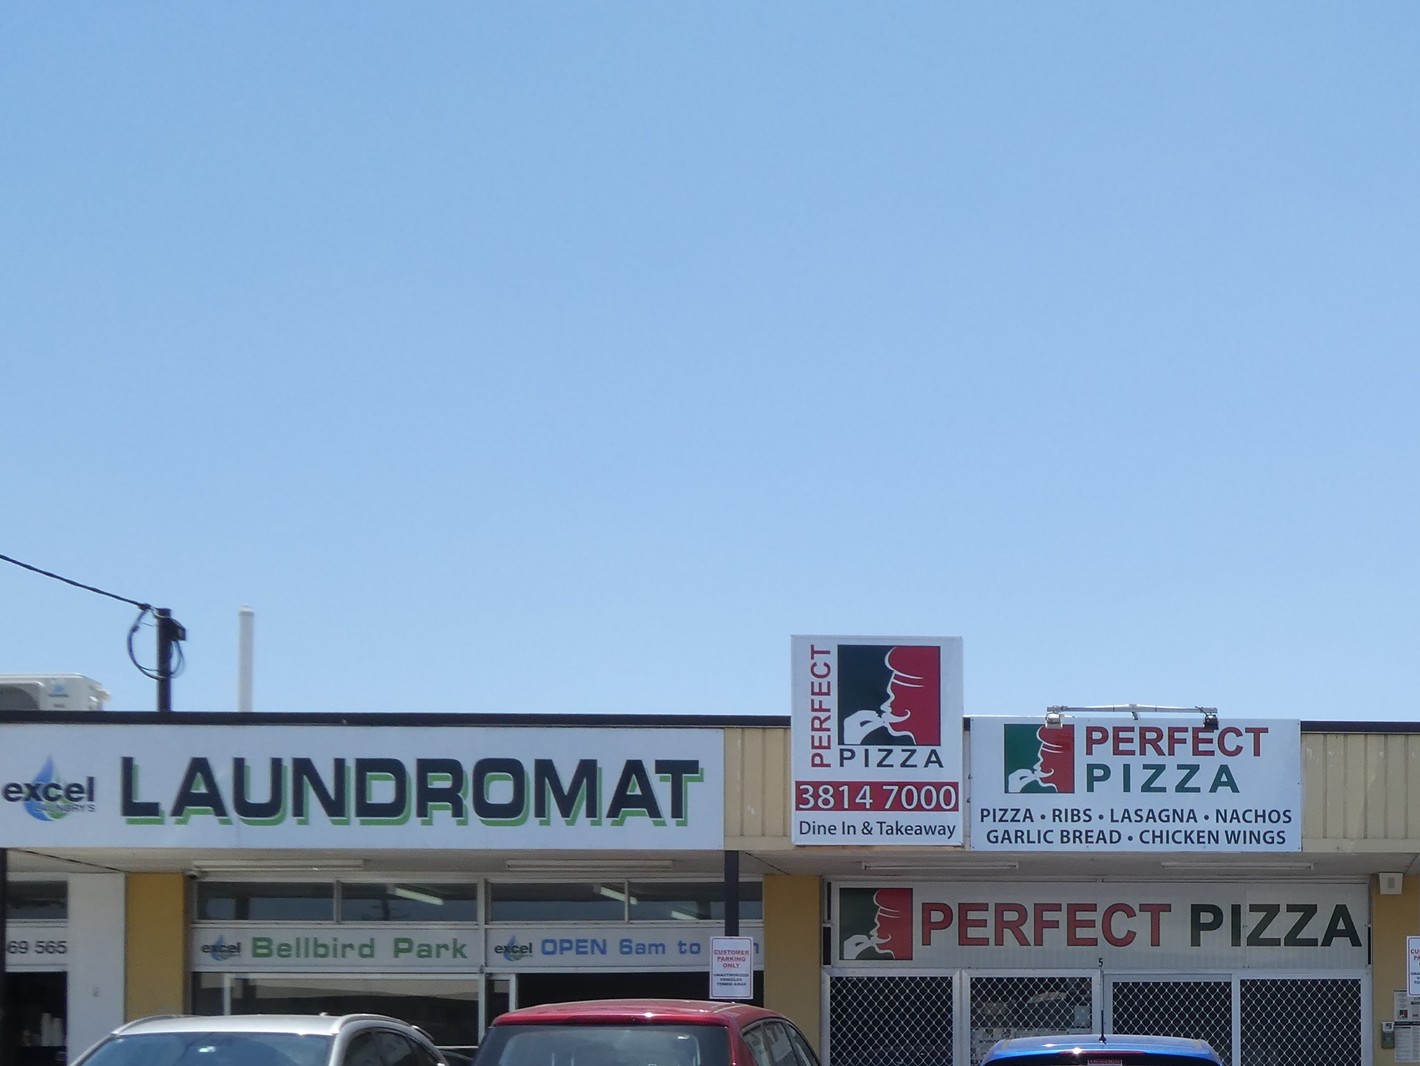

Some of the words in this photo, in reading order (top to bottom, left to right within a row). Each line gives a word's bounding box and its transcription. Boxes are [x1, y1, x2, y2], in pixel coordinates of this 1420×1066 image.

[811, 645, 831, 768] PERFECT
[1085, 726, 1269, 757] PERFECT
[839, 749, 944, 768] PIZZA
[1085, 764, 1241, 794] PIZZA
[2, 776, 96, 803] excel
[121, 757, 703, 826] LAUNDROMAT
[799, 784, 873, 809] 3814
[882, 784, 956, 810] 7000
[980, 808, 1035, 823] PIZZA
[1051, 808, 1093, 823] RIBS
[1110, 808, 1198, 823] LASAGNA
[1215, 808, 1292, 824] NACHOS
[799, 821, 837, 836] Dine
[842, 821, 857, 836] In
[861, 822, 873, 836] &
[876, 821, 956, 840] Takeaway
[986, 829, 1054, 844] GARLIC
[1060, 829, 1122, 844] BREAD
[1139, 829, 1220, 844] CHICKEN
[1225, 829, 1286, 845] WINGS
[921, 902, 1172, 948] PERFECT
[1190, 903, 1363, 948] PIZZA
[34, 940, 67, 954] 565
[252, 937, 375, 959] Bellbird
[393, 937, 468, 959] Park
[494, 942, 533, 954] excel
[541, 938, 607, 956] OPEN
[619, 938, 666, 955] 6am
[678, 939, 701, 955] to
[1098, 957, 1103, 968] 5
